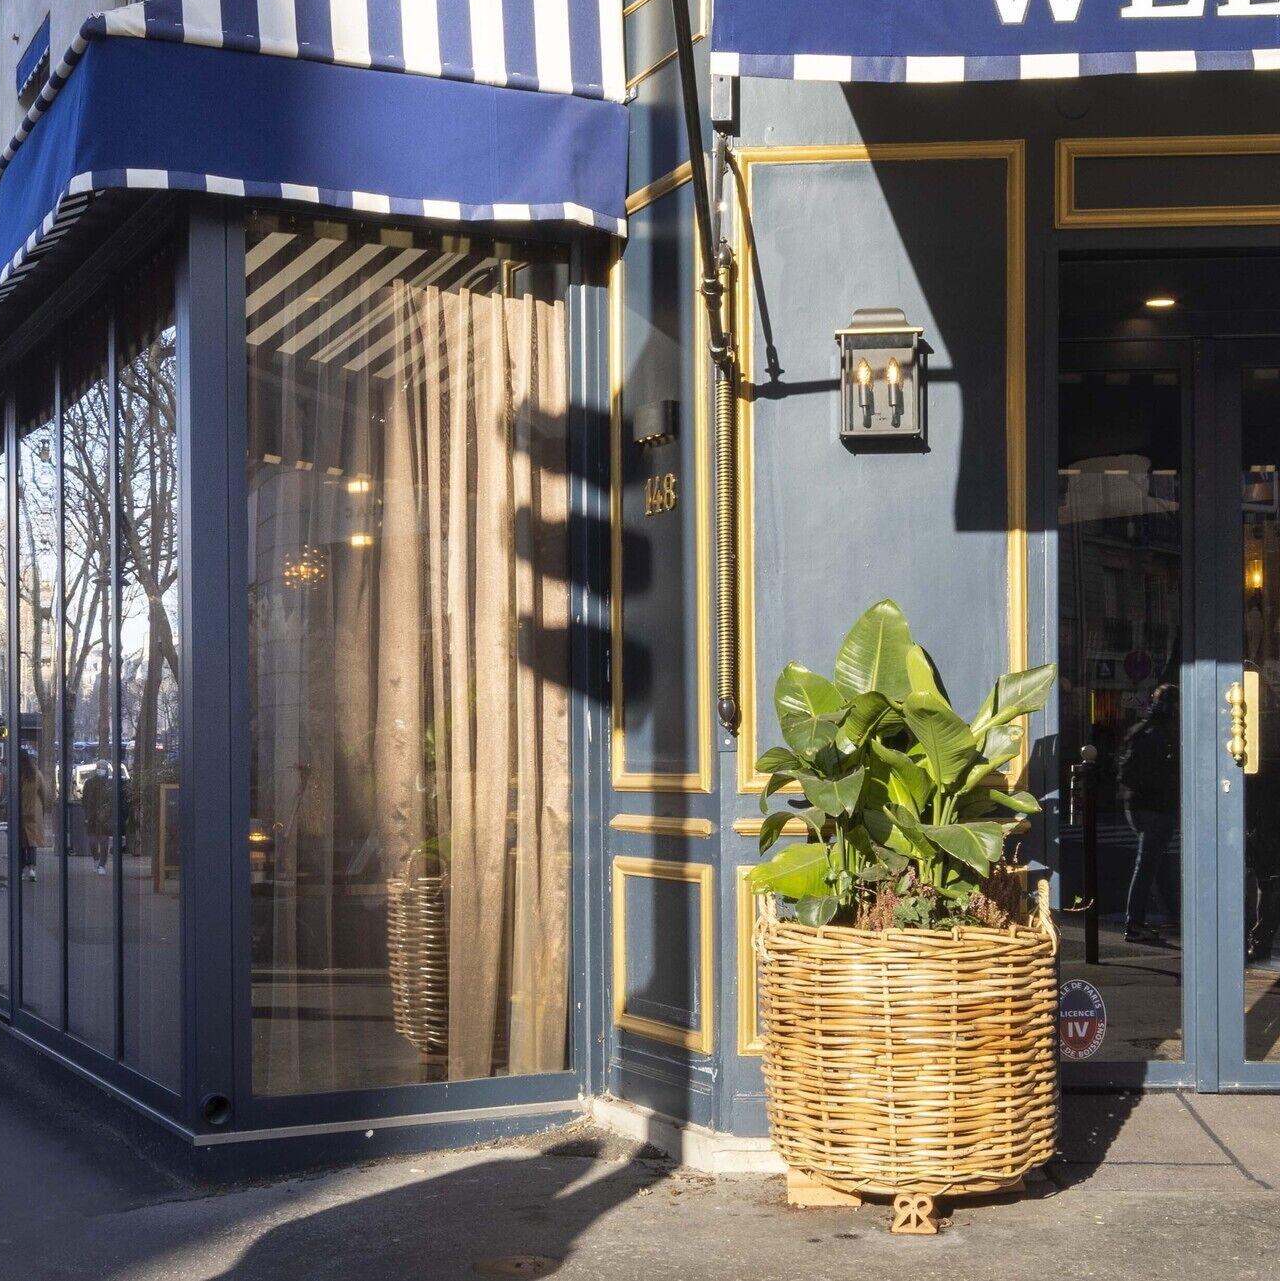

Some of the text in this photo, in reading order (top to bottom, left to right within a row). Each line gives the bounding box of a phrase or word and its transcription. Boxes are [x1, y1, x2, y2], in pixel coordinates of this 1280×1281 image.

[1071, 981, 1082, 990] DE
[1083, 985, 1102, 1009] PARIS
[1067, 1021, 1089, 1038] IV
[1078, 1022, 1105, 1058] BOISSONS
